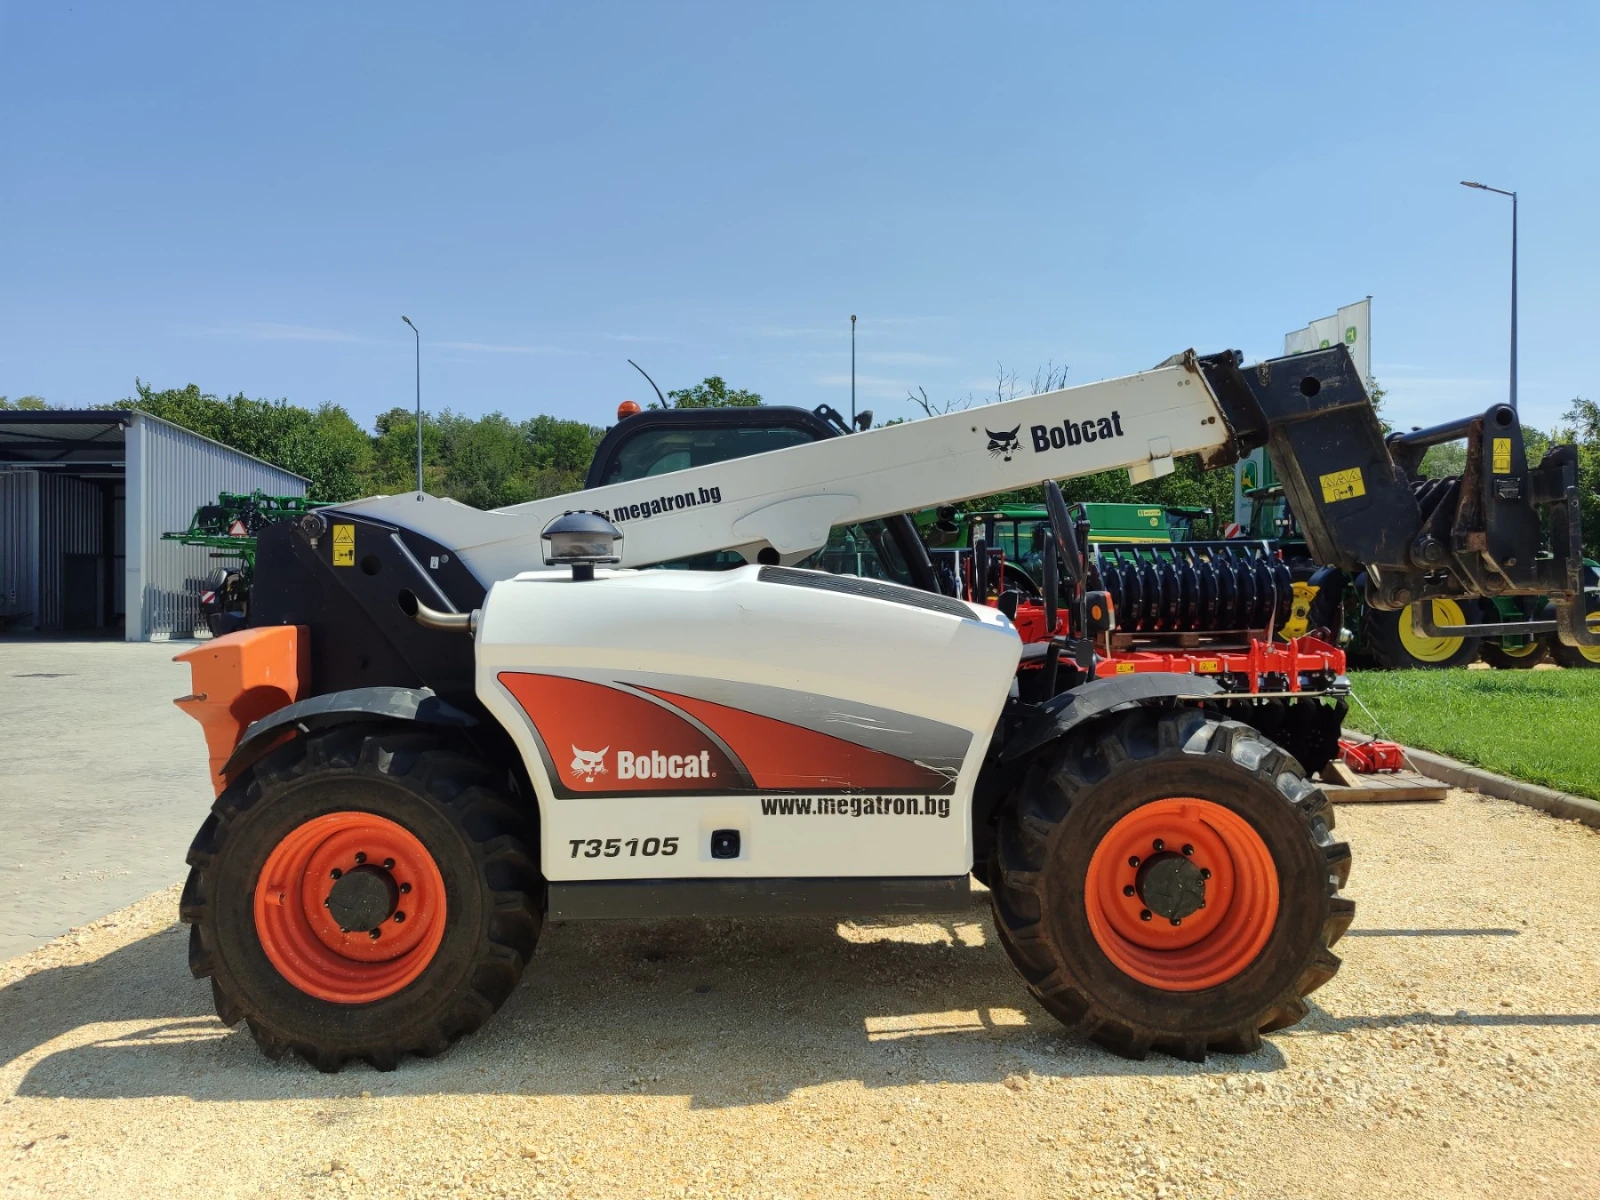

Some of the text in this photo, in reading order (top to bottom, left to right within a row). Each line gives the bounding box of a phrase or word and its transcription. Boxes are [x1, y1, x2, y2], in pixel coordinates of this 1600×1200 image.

[1030, 410, 1124, 453] Bobcat
[617, 750, 710, 780] Bobcat
[761, 796, 950, 818] www.megatron.bg
[569, 837, 679, 858] T35105
